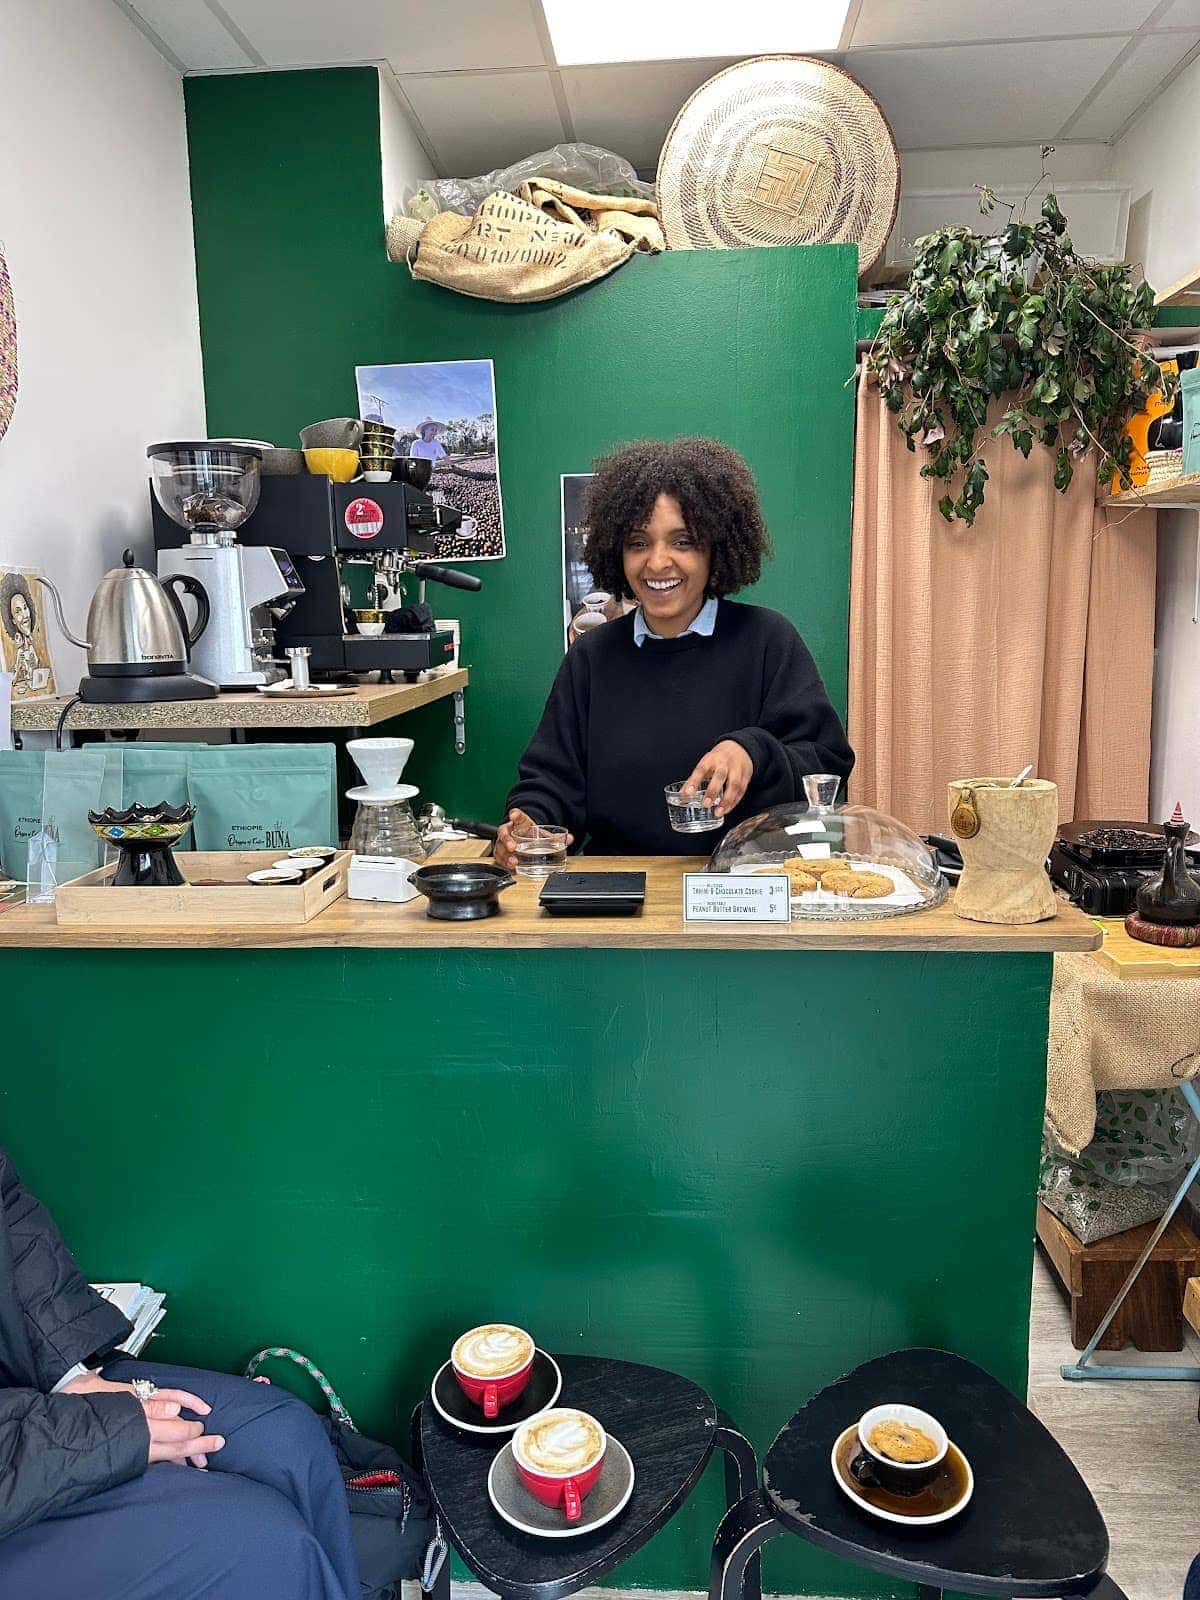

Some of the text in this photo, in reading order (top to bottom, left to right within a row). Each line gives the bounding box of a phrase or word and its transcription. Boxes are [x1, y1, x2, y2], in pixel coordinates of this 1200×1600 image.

[265, 830, 291, 848] BUNA
[692, 905, 711, 913] PEANUT
[713, 905, 731, 913] BUTTER
